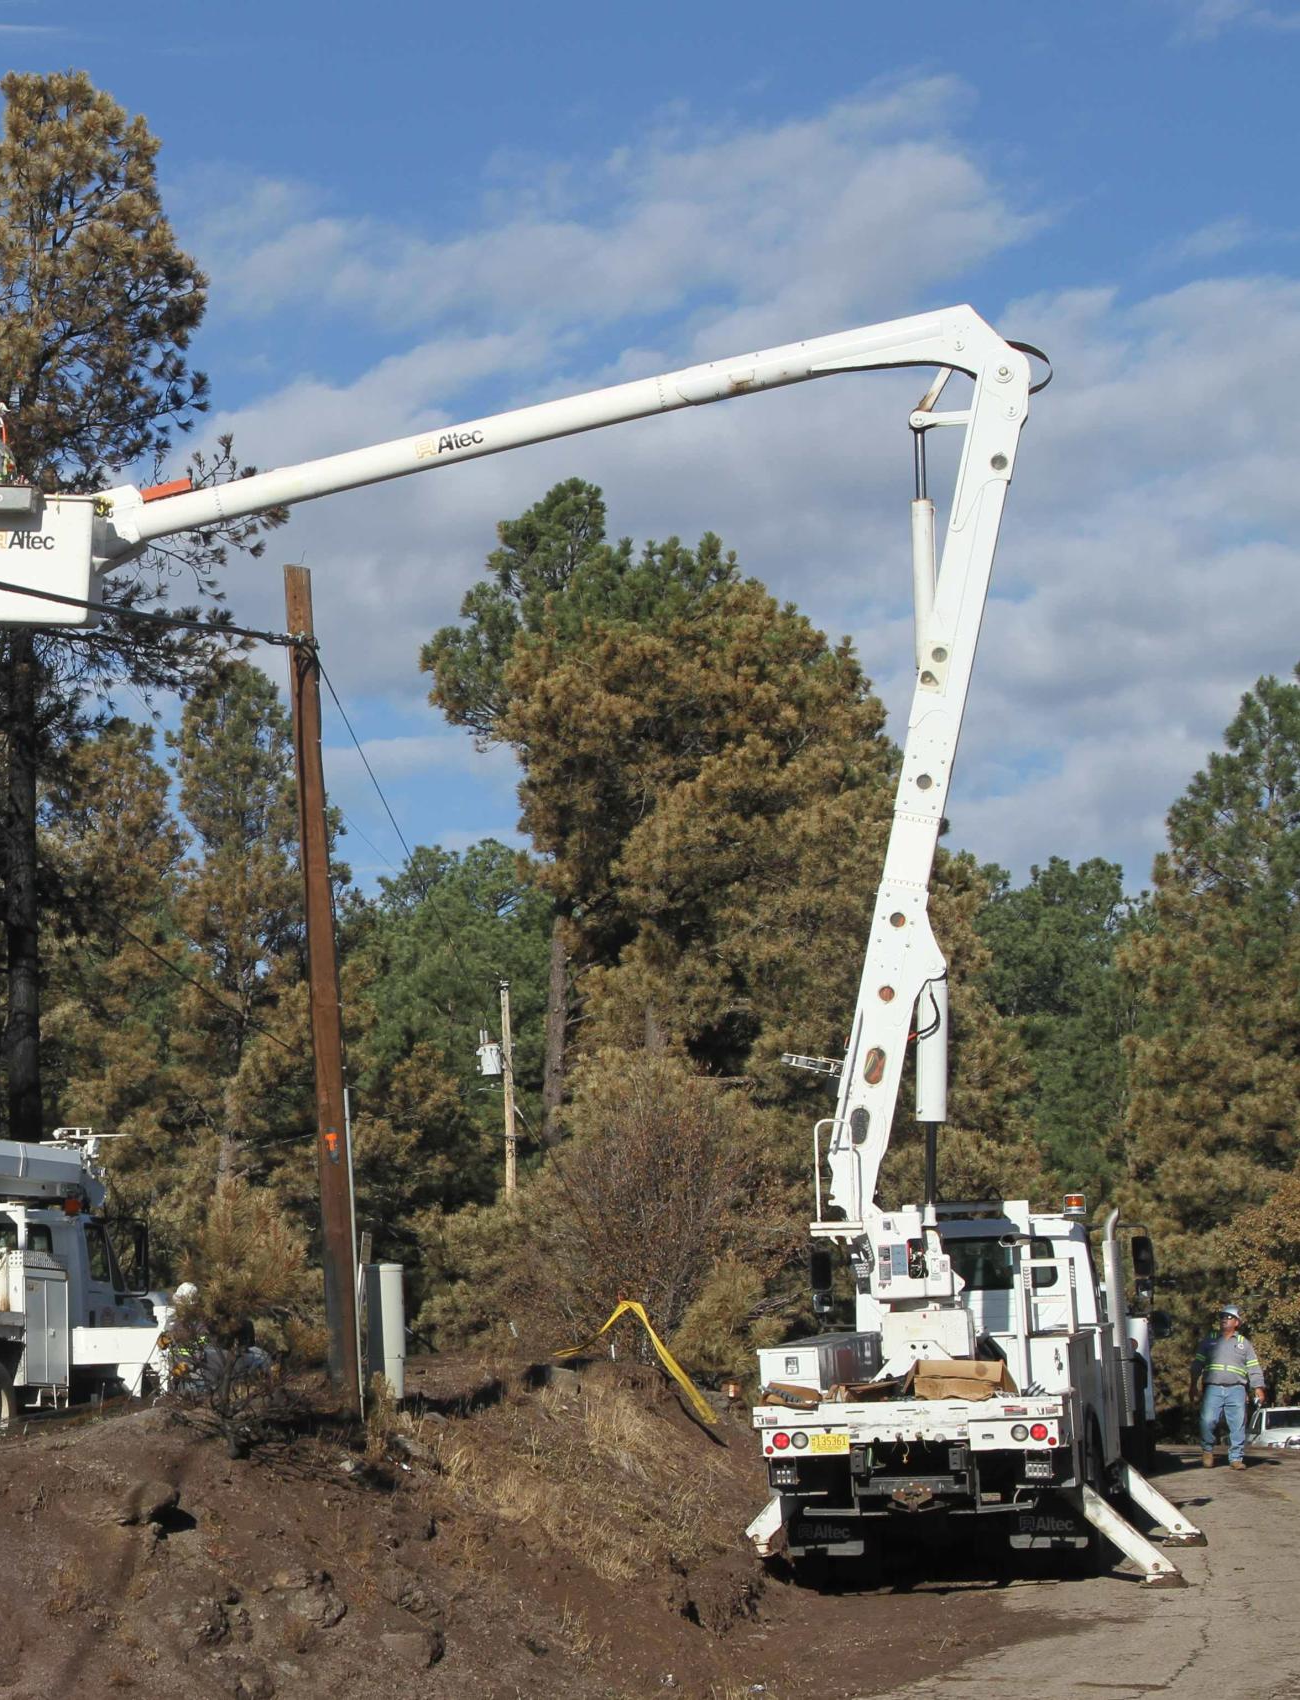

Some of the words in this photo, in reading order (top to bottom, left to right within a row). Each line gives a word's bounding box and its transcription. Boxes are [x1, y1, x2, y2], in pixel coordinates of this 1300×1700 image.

[438, 430, 484, 454] Altec
[8, 530, 55, 550] Altec
[816, 1436, 847, 1447] 135361
[814, 1523, 851, 1539] Altec
[1036, 1516, 1075, 1531] Altec
